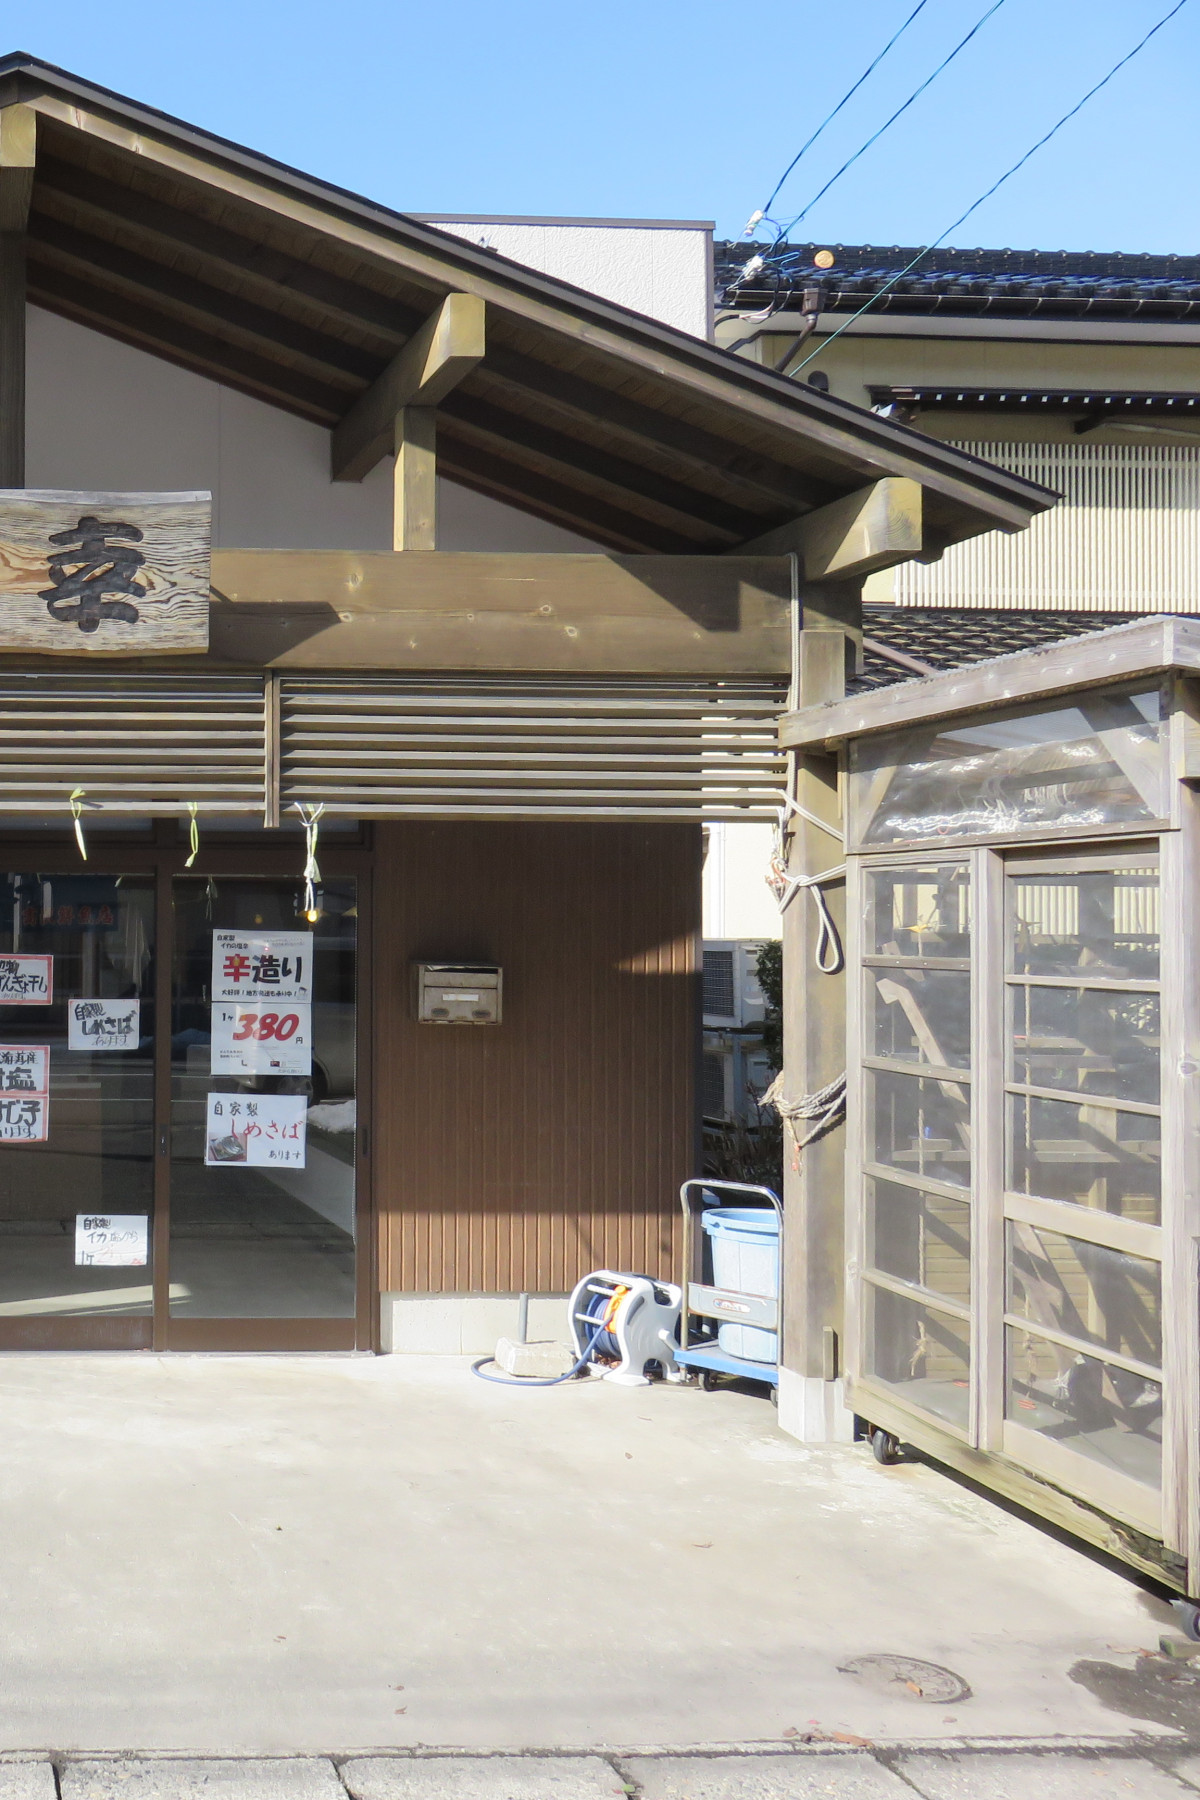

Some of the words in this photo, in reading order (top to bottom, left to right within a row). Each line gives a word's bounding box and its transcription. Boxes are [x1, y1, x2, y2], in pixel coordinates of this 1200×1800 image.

[223, 953, 302, 984] 辛造り
[81, 1010, 137, 1036] しめさば
[214, 1101, 258, 1117] 自家製
[231, 1118, 304, 1140] しめさば
[268, 1150, 301, 1160] あります
